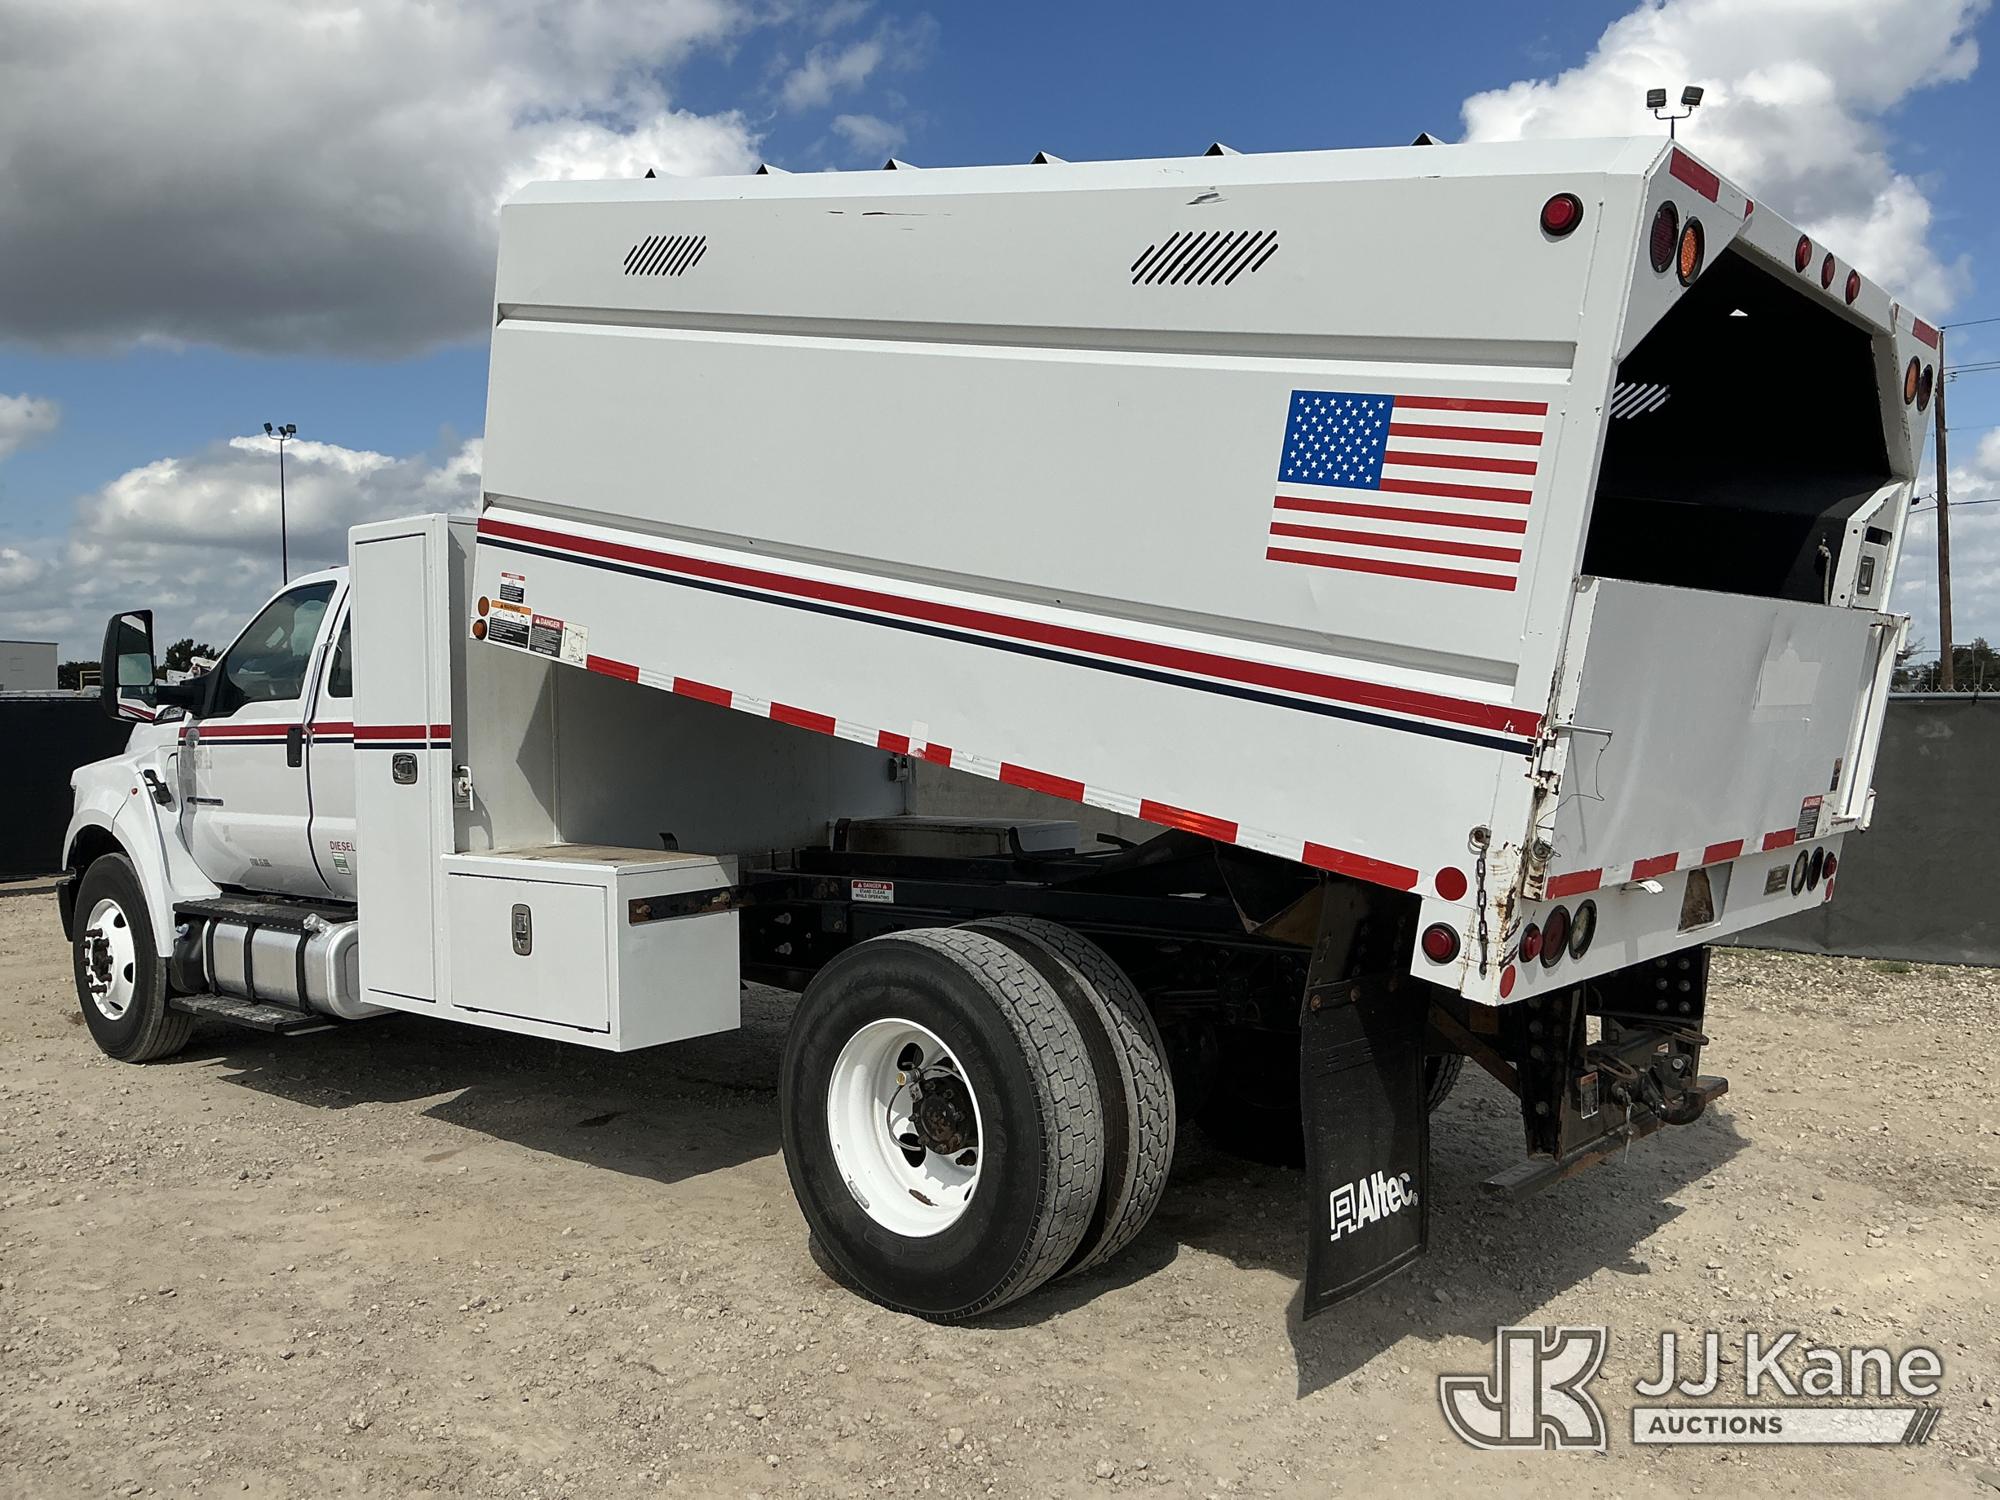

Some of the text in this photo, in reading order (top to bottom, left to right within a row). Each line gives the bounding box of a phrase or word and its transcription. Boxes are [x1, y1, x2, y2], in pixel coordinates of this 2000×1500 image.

[540, 617, 560, 629] DANGER
[329, 840, 356, 852] DIESEL
[1357, 1170, 1413, 1230] Altec
